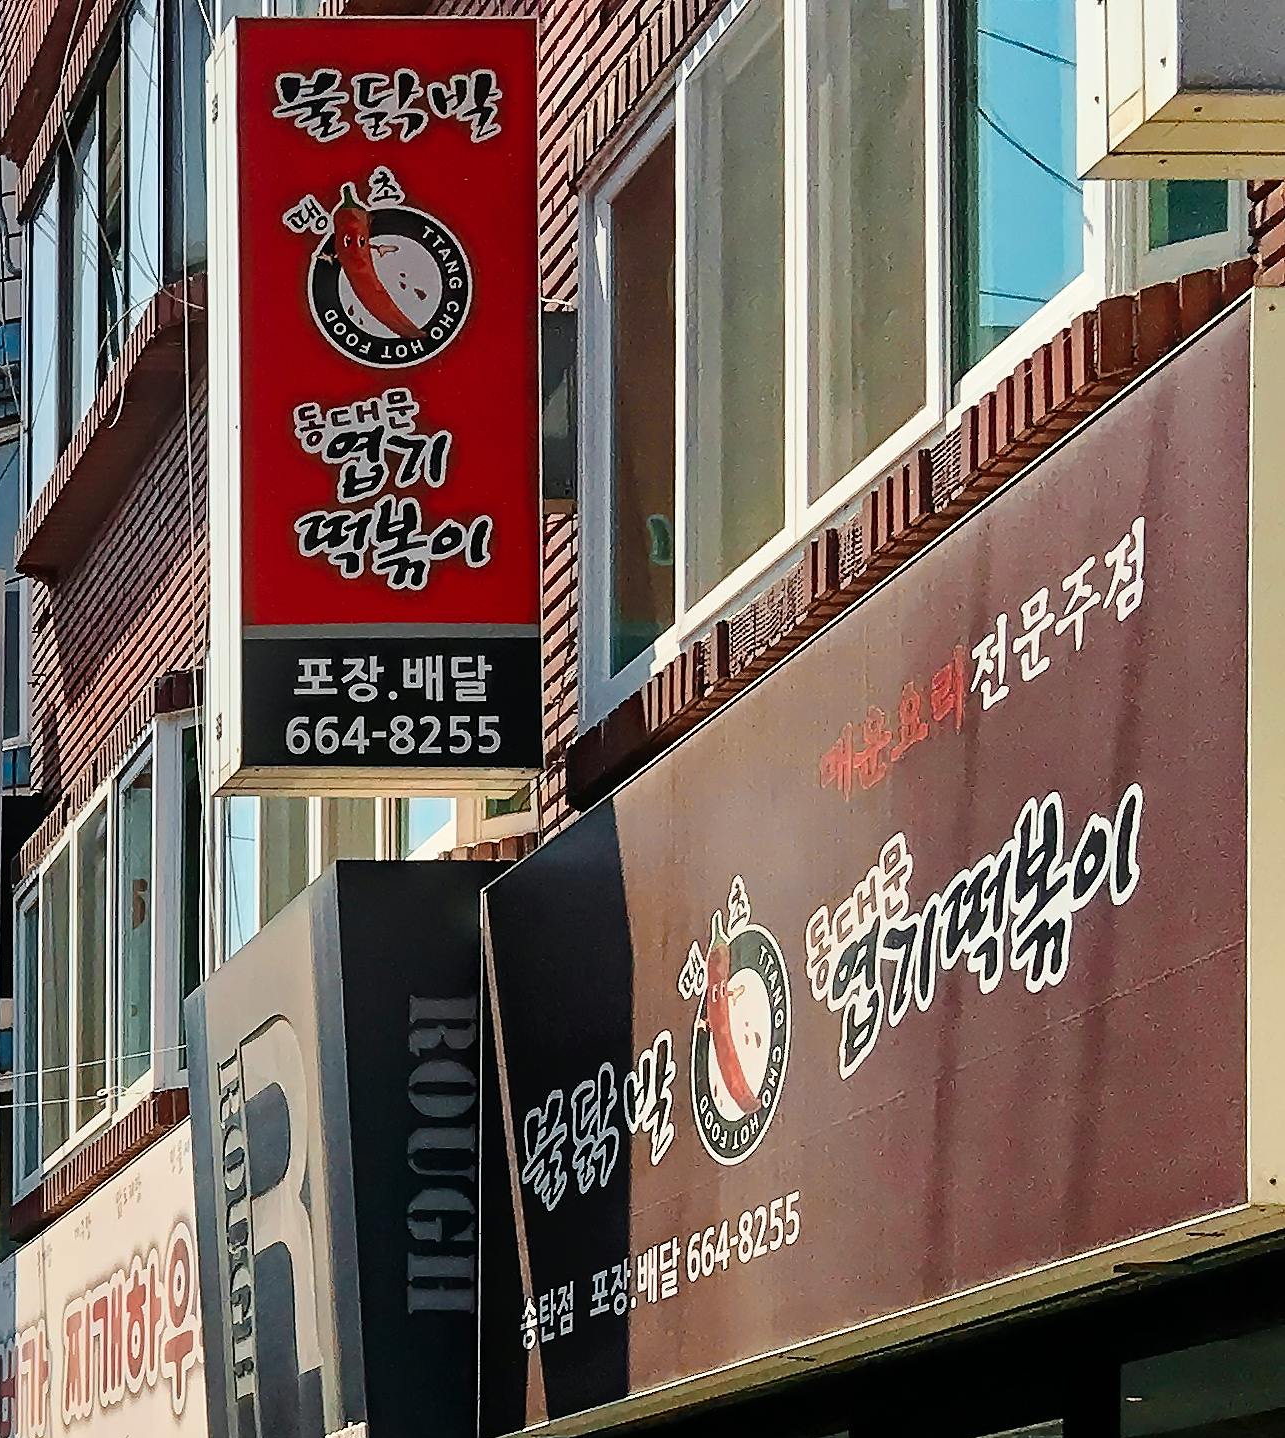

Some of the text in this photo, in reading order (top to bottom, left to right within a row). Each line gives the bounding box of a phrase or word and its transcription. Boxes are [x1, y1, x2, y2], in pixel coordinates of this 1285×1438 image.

[273, 68, 503, 142] 불닭발
[325, 226, 463, 359] TTANG CHO HOT FOOD
[294, 388, 419, 453] 동대문
[323, 424, 451, 503] 엽기
[294, 494, 493, 590] 떡볶이
[968, 516, 1146, 710] 전문주점
[285, 715, 502, 755] 664-8255
[407, 995, 478, 1315] ROUGH
[521, 1029, 677, 1212] 불닭발
[64, 1237, 196, 1412] 찌개하우
[520, 1281, 574, 1350] 송탄점
[685, 1190, 802, 1282] 664-8255
